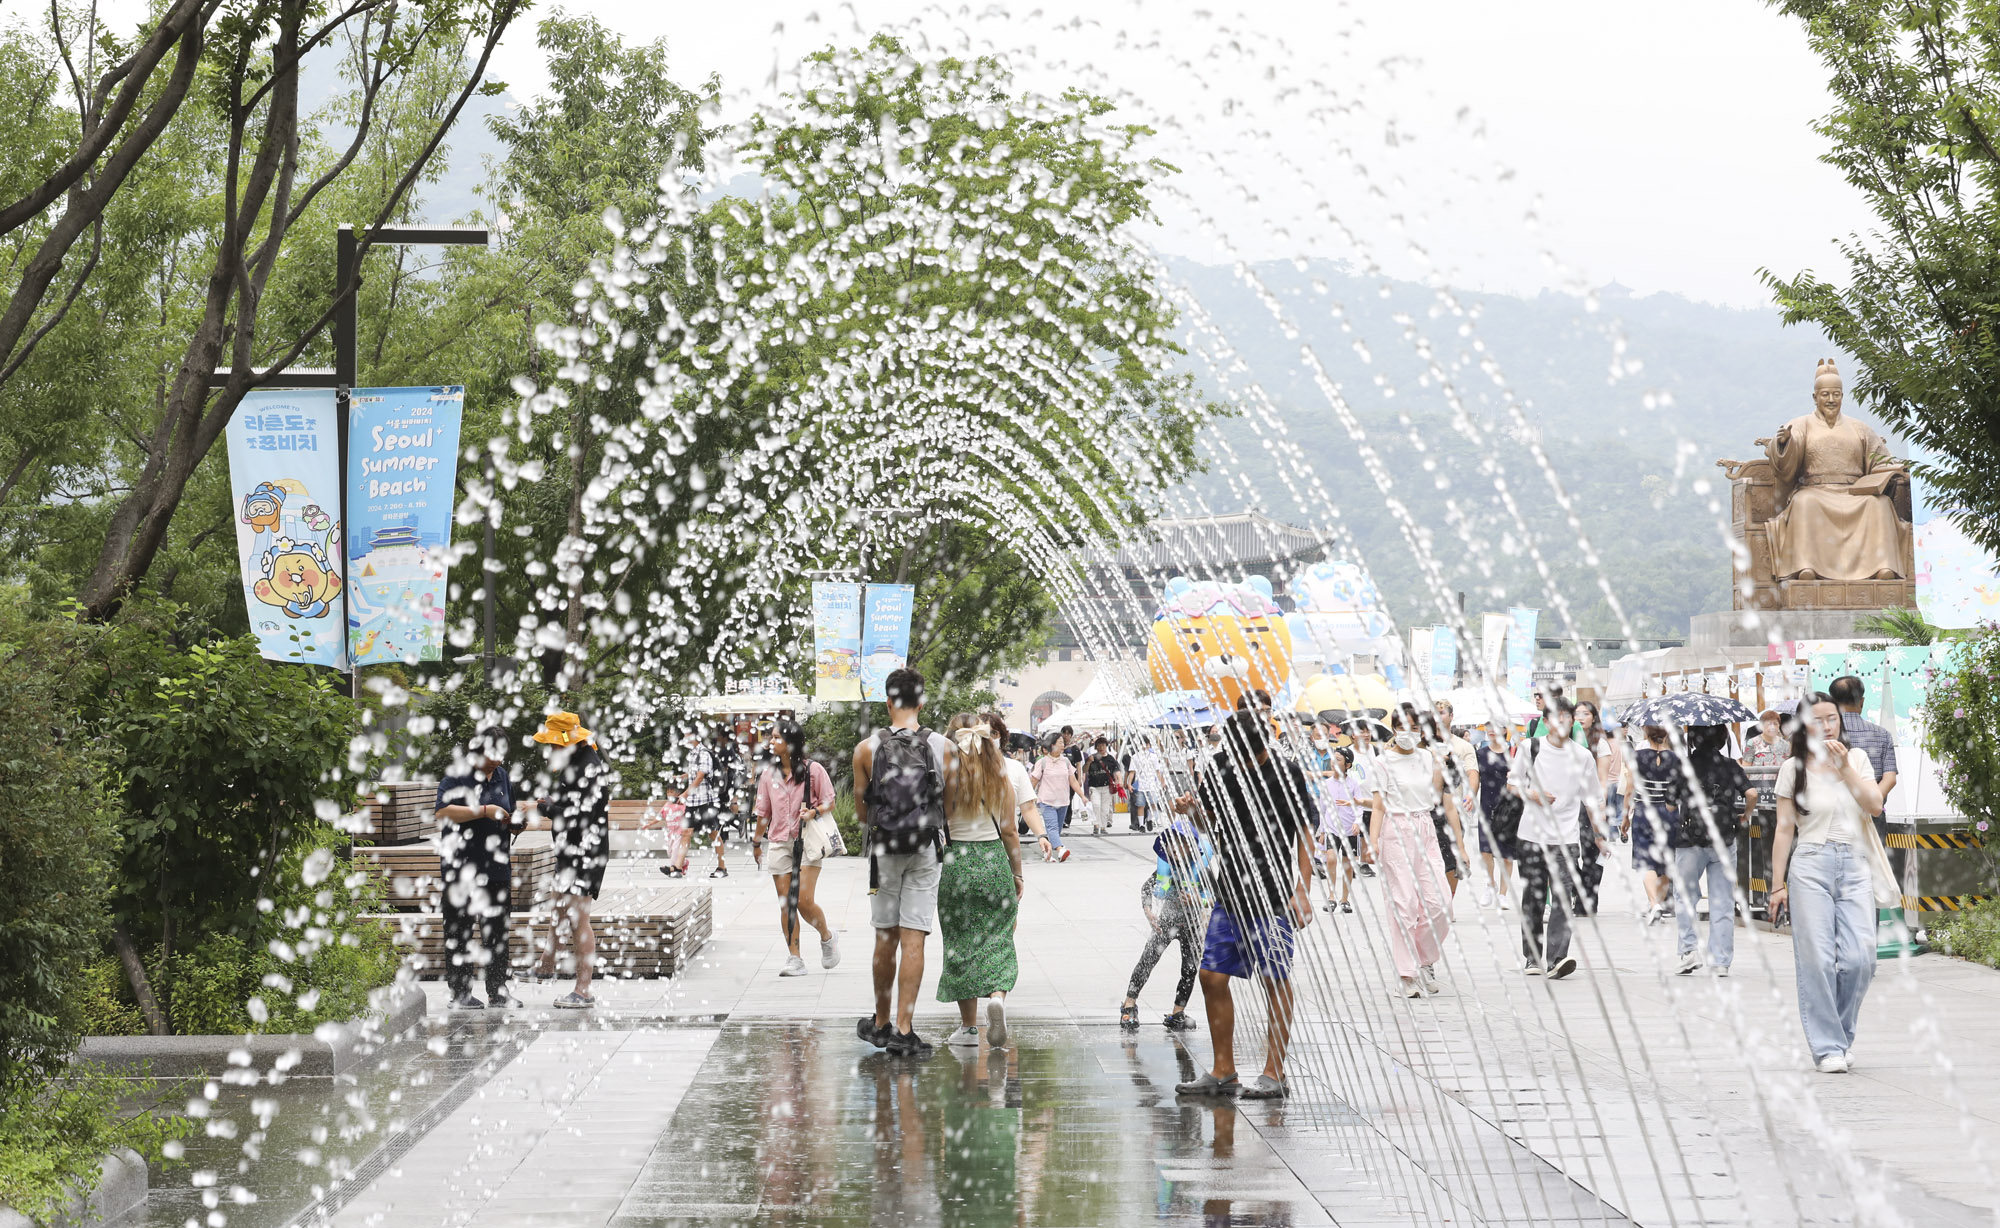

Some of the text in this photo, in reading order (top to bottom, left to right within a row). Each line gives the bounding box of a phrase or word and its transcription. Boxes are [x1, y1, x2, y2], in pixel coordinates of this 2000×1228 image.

[259, 404, 290, 413] WELCOME
[411, 407, 433, 416] 2024
[371, 425, 434, 453] Seoul
[361, 455, 440, 477] Summer
[369, 477, 427, 499] Beach
[875, 599, 902, 612] Seoul
[871, 613, 904, 624] Summer
[874, 623, 899, 632] Beach
